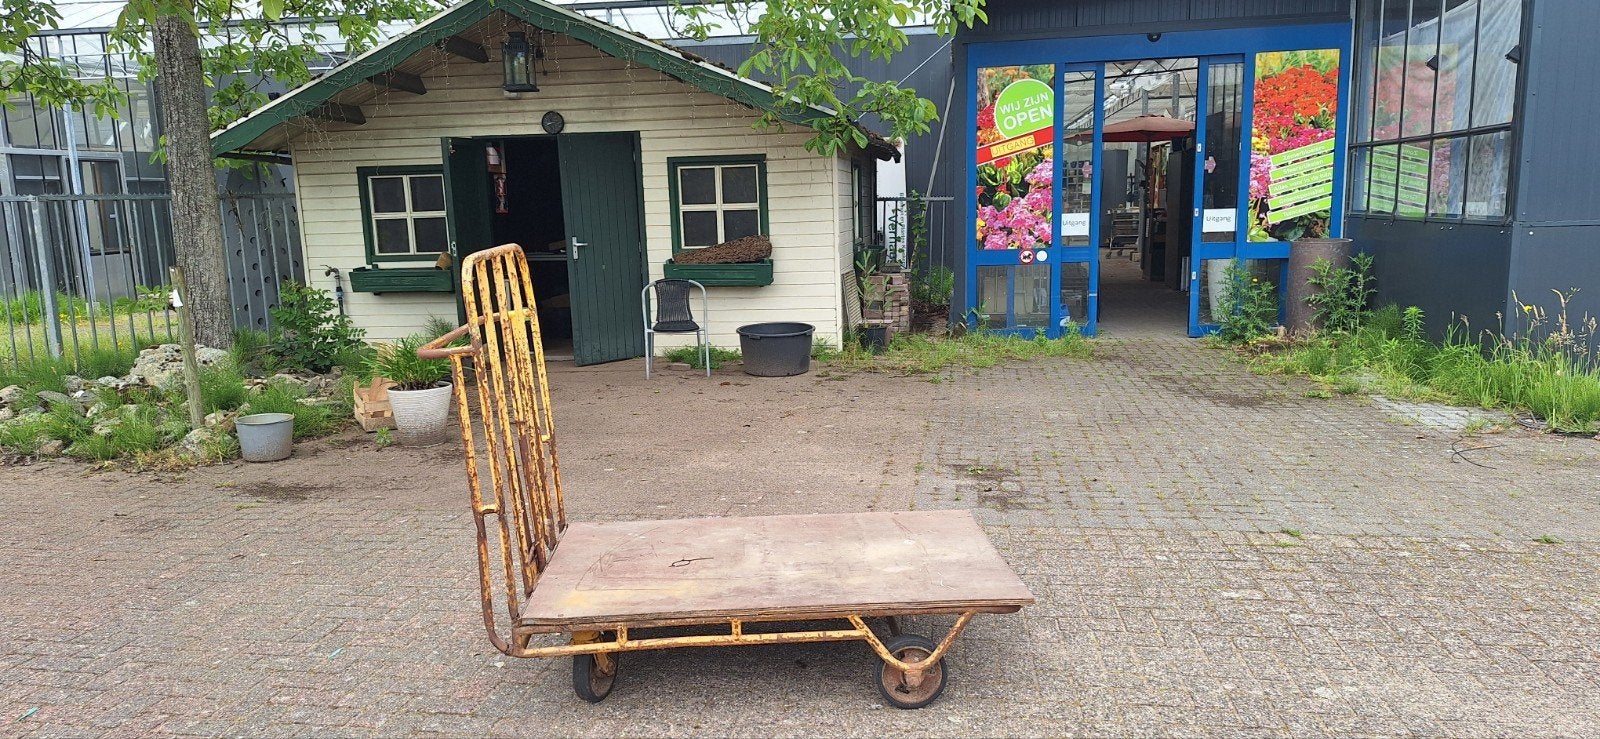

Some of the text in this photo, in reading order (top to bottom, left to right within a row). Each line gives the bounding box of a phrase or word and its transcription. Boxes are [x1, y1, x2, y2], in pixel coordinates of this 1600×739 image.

[1000, 92, 1049, 115] WIJ ZIJN
[1003, 104, 1053, 130] OPEN
[992, 136, 1034, 155] UITGANG
